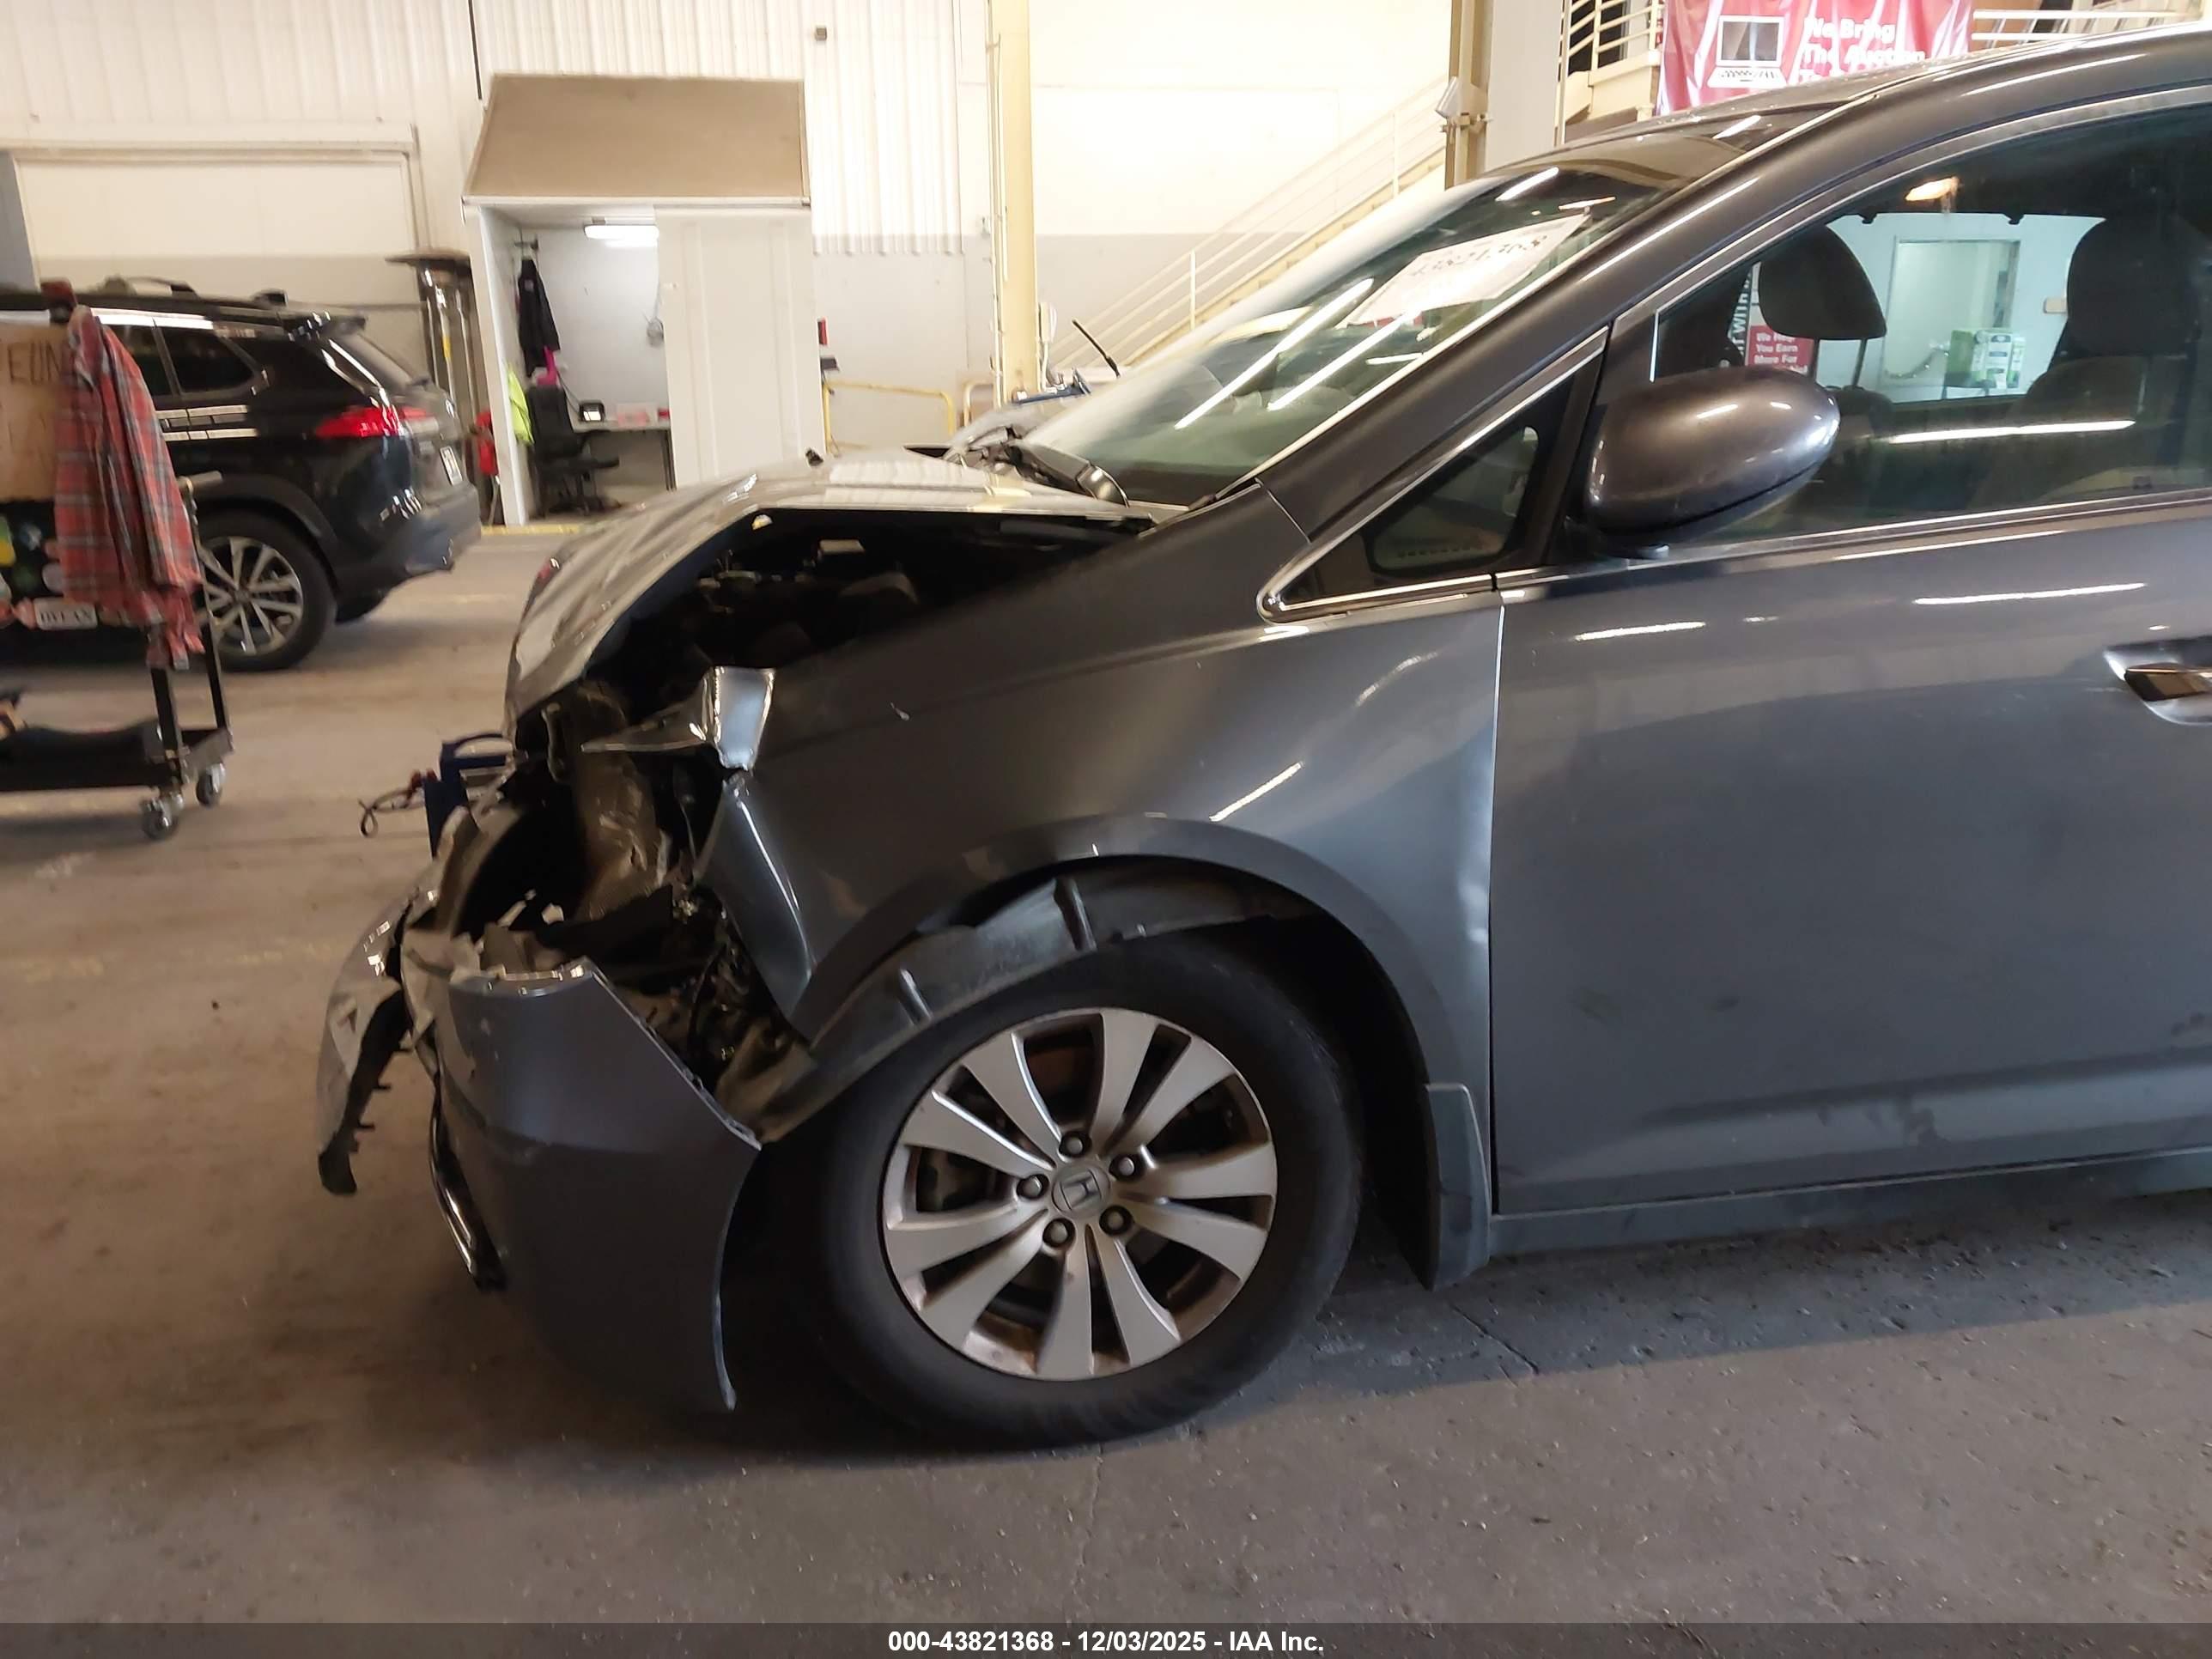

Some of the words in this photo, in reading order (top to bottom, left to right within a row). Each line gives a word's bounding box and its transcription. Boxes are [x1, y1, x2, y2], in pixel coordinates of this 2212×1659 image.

[1804, 17, 1835, 39] We
[1840, 18, 1896, 44] Bring
[1756, 343, 1774, 353] You
[1775, 343, 1798, 352] Earn
[1754, 354, 1779, 364] More
[1781, 354, 1797, 364] For
